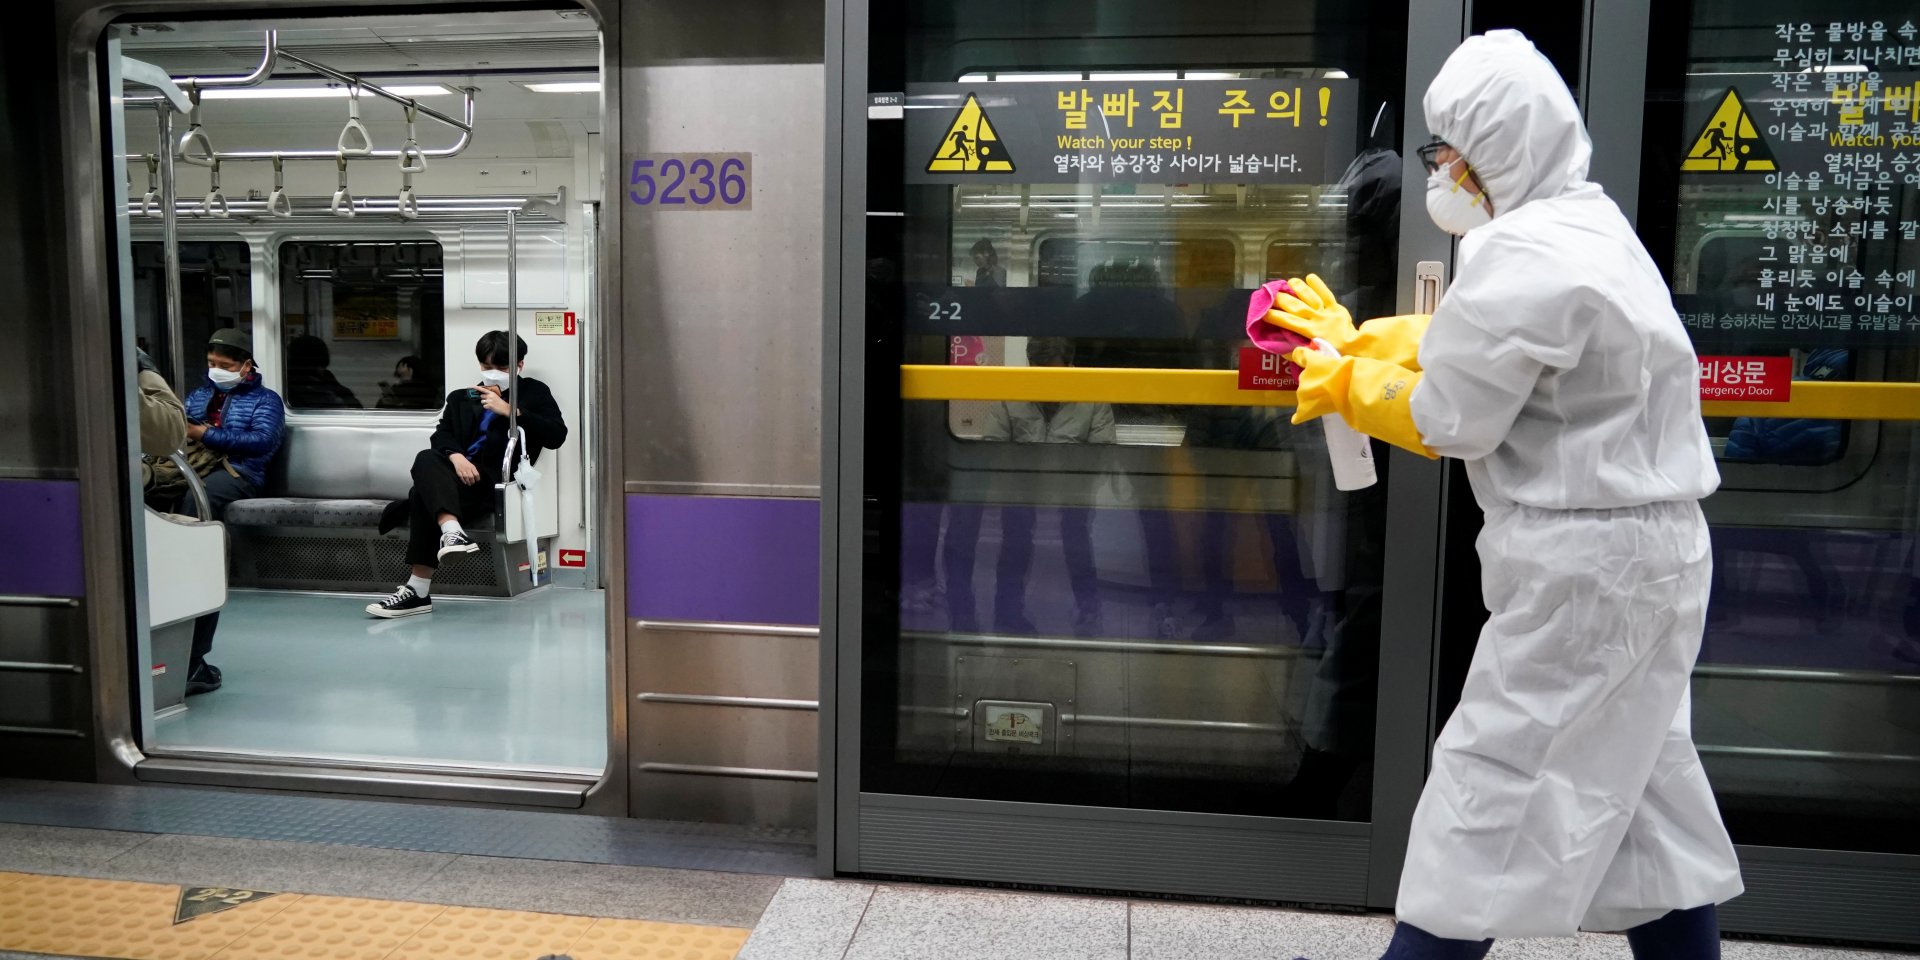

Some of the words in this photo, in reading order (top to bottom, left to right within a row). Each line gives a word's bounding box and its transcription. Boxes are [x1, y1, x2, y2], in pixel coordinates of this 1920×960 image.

[1775, 23, 1815, 43] 작은
[1825, 21, 1887, 42] 물방울
[1773, 47, 1832, 67] 무심히
[1843, 46, 1920, 66] 지나치면
[1771, 72, 1812, 93] 작은
[1822, 71, 1883, 92] 물방울
[1057, 88, 1183, 129] 발빠짐
[1770, 98, 1829, 117] 우연히
[1768, 122, 1828, 141] 이슬과
[1838, 122, 1879, 140] 함께
[1830, 132, 1884, 147] Watch
[1057, 136, 1104, 149] Watch
[1111, 138, 1144, 151] your
[1150, 137, 1181, 151] step
[1053, 154, 1104, 173] 열차와
[1112, 154, 1163, 173] 승강장
[1170, 154, 1221, 173] 사이가
[1229, 154, 1302, 173] 넓습니다.
[1824, 152, 1883, 173] 열차와
[630, 158, 746, 206] 5236
[1765, 171, 1824, 191] 이슬을
[1834, 171, 1894, 191] 머금은
[1763, 196, 1801, 215] 시를
[1812, 196, 1893, 216] 낭송하듯
[1828, 220, 1888, 240] 소리를
[1759, 246, 1778, 261] 그
[1789, 244, 1848, 263] 맑음에
[1826, 269, 1865, 288] 이슬
[1875, 269, 1915, 288] 속에
[929, 302, 962, 320] 2-2
[1756, 293, 1775, 311] 내
[1784, 293, 1844, 312] 눈에도
[1854, 293, 1912, 312] 이슬이
[1719, 313, 1777, 330] 승하차는
[1781, 313, 1852, 331] 안전사고를
[1857, 314, 1902, 331] 유발할
[1699, 361, 1766, 384] 비상문
[1748, 386, 1774, 396] Door
[188, 888, 253, 904] 2-2
